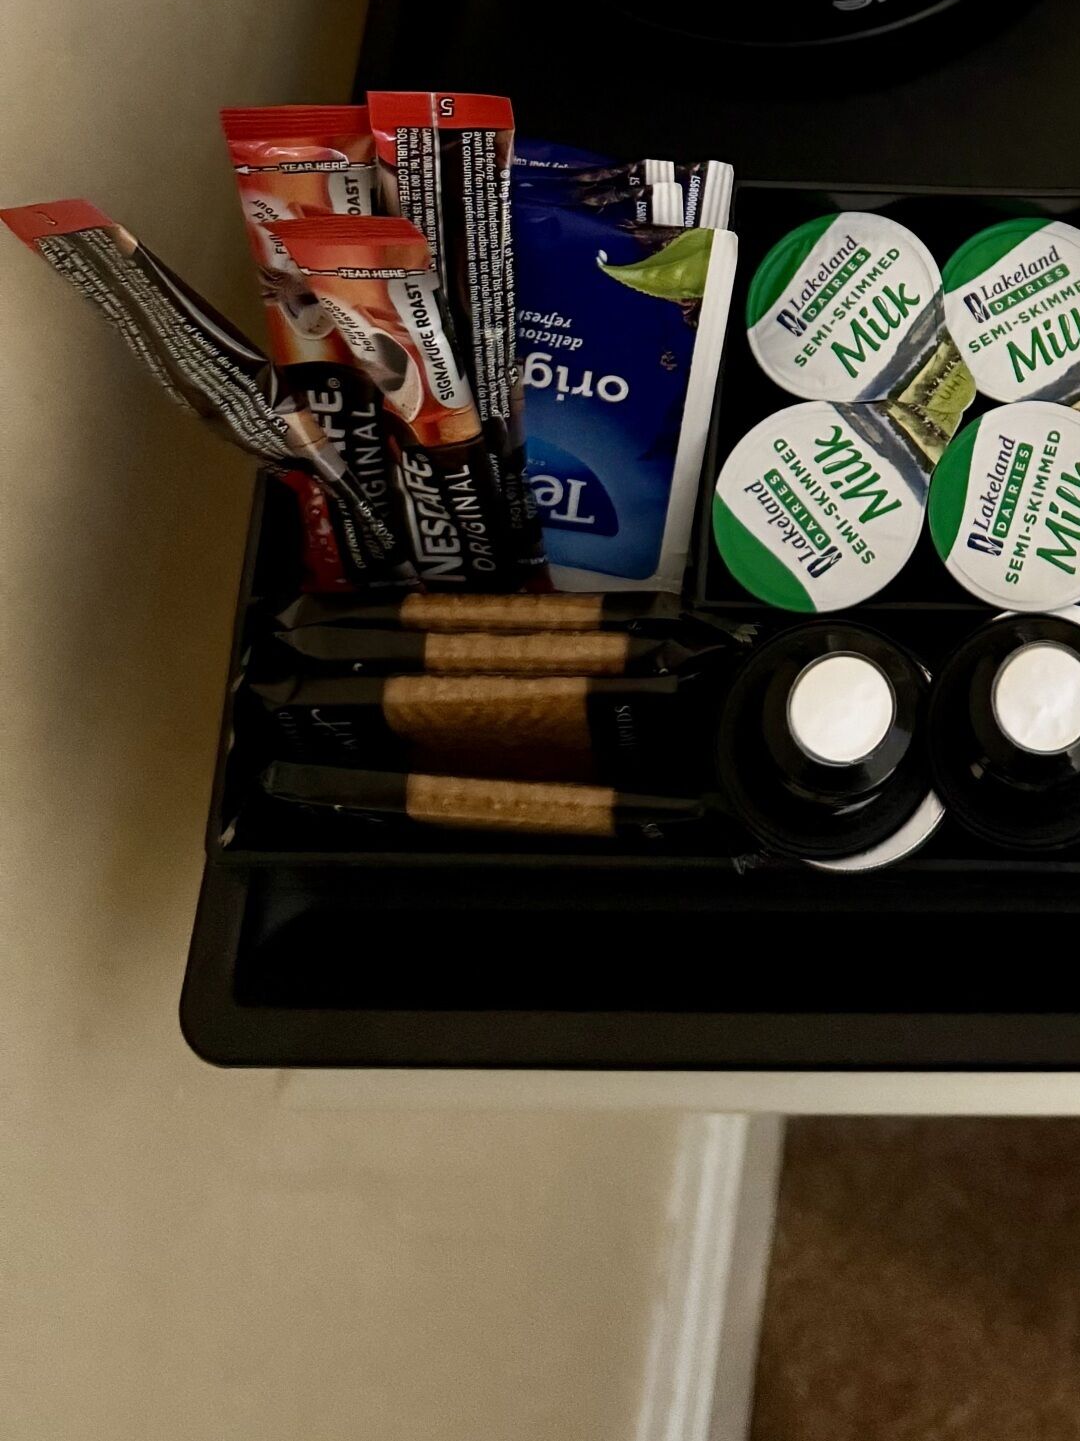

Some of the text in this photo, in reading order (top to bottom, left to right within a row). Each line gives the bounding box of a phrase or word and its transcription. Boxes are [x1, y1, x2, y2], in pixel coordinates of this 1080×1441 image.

[396, 127, 408, 167] SOLUBLE
[409, 128, 420, 148] Praha
[461, 131, 472, 144] Da
[474, 131, 484, 155] avant
[485, 131, 495, 150] Best
[281, 161, 349, 172] TEAR HERE
[422, 155, 433, 178] DUBLIN
[462, 145, 474, 195] consumarsi
[474, 157, 485, 189] fin/Ten
[486, 152, 497, 181] Before
[344, 175, 361, 216] OAST
[412, 188, 421, 201] 135
[413, 202, 423, 214] 135
[476, 189, 487, 219] minste
[462, 196, 476, 260] preferibilmente
[487, 181, 500, 249] End/Mindestens
[268, 233, 288, 255] Full
[478, 220, 490, 260] houdbaar
[340, 268, 406, 278] TEAR HERE
[468, 261, 478, 284] entro
[480, 261, 490, 273] tot
[491, 249, 503, 278] haltbar
[789, 235, 860, 313] Lakeland
[980, 245, 1062, 301] Lakeland
[493, 279, 503, 290] bis
[807, 251, 868, 318] DAIRIES
[993, 268, 1065, 311] DAIRIES
[470, 284, 482, 346] fine/Minimálna
[794, 247, 901, 368] SEMI-SKIMMED
[354, 331, 376, 352] bold
[404, 282, 455, 401] SIGNATURE ROAST
[831, 282, 920, 378] Milk
[217, 356, 233, 369] des
[524, 352, 629, 402] orig
[940, 373, 967, 402] UHT
[813, 425, 902, 525] Milk
[973, 434, 1016, 532] Lakeland
[994, 448, 1030, 533] DAIRIES
[444, 464, 497, 572] ORIGINAL
[529, 474, 596, 524] Te
[770, 474, 824, 545] DAIRIES
[773, 438, 876, 565] SEMI-SKIMMED
[1005, 429, 1061, 585] SEMI-SKIMMED
[744, 479, 816, 563] Lakeland
